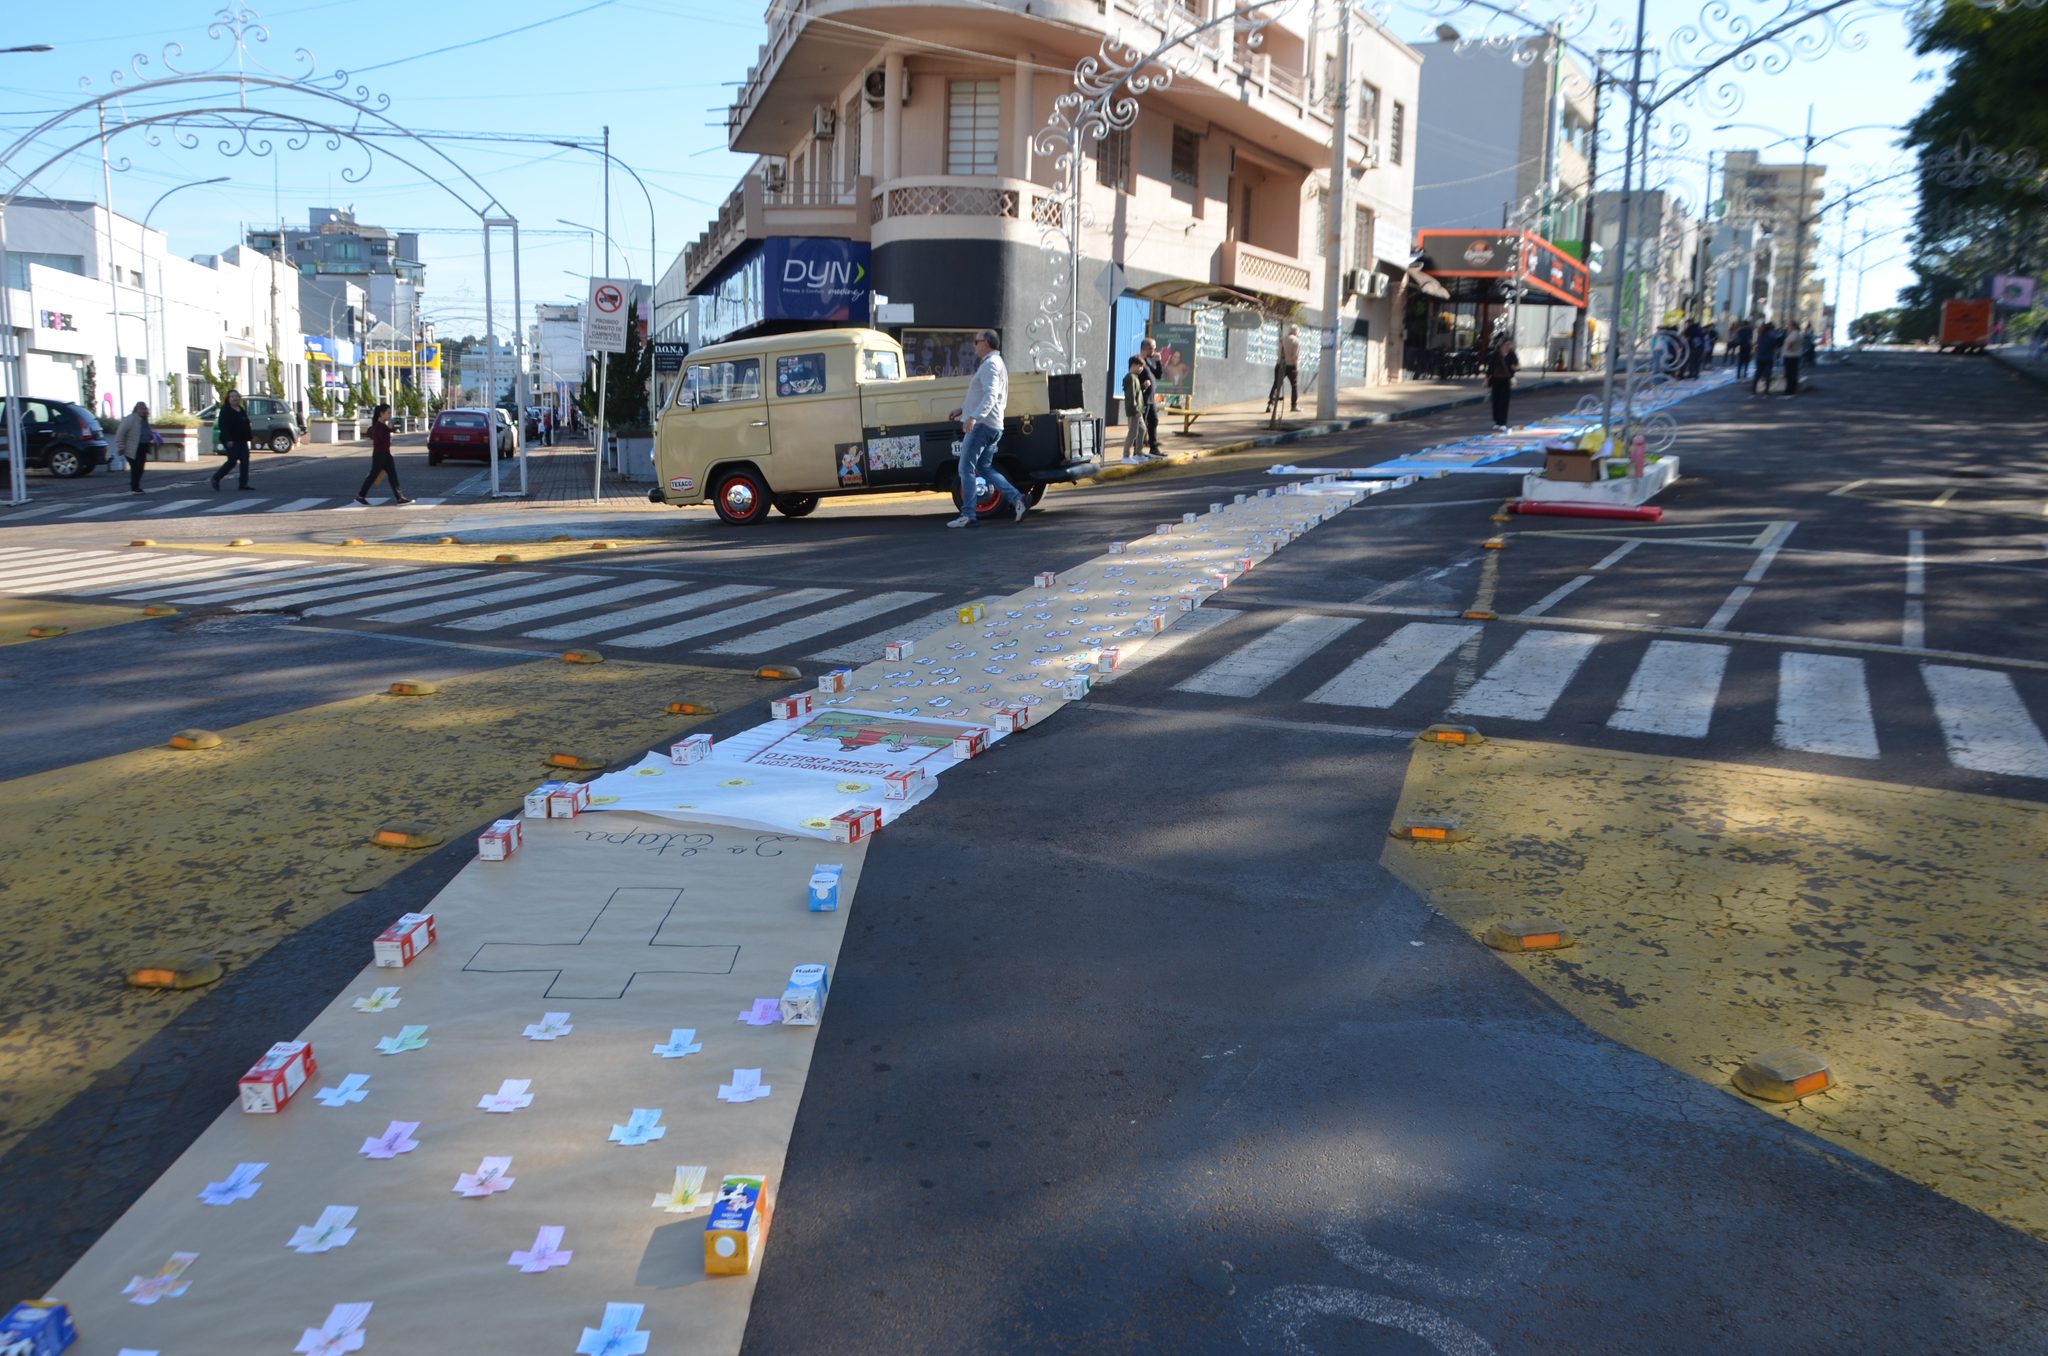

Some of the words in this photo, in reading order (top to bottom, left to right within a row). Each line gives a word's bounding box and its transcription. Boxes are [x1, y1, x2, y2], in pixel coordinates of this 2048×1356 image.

[755, 759, 789, 767] COM
[763, 752, 830, 764] CRISTO
[832, 759, 894, 768] JESUS
[789, 762, 887, 775] CAMINHANDO
[574, 826, 714, 857] Etapa
